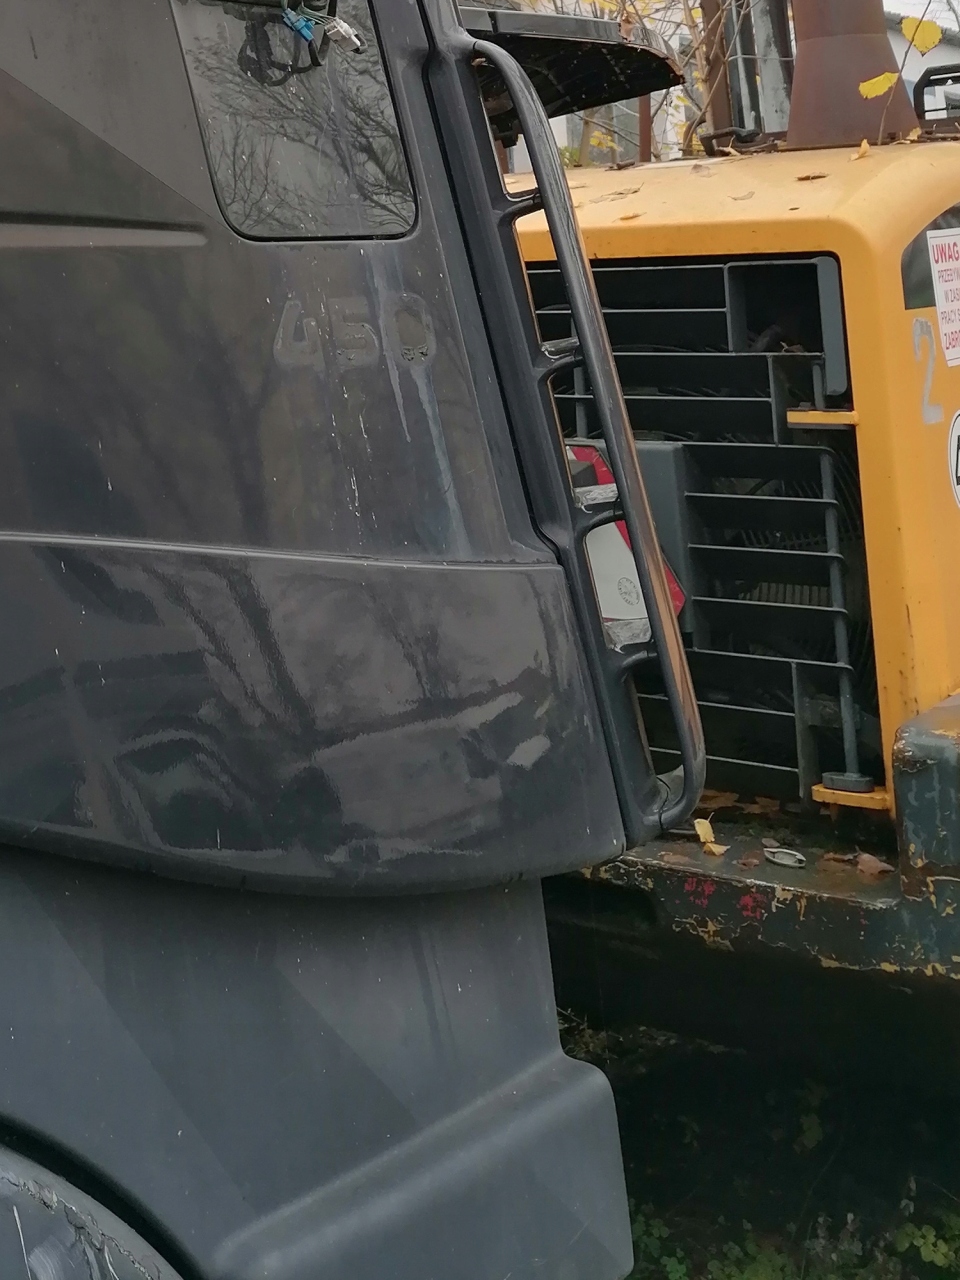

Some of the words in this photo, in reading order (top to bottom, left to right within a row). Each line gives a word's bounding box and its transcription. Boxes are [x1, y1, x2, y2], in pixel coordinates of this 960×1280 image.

[932, 241, 960, 264] UWAG
[273, 291, 437, 370] 450
[912, 318, 944, 424] 2
